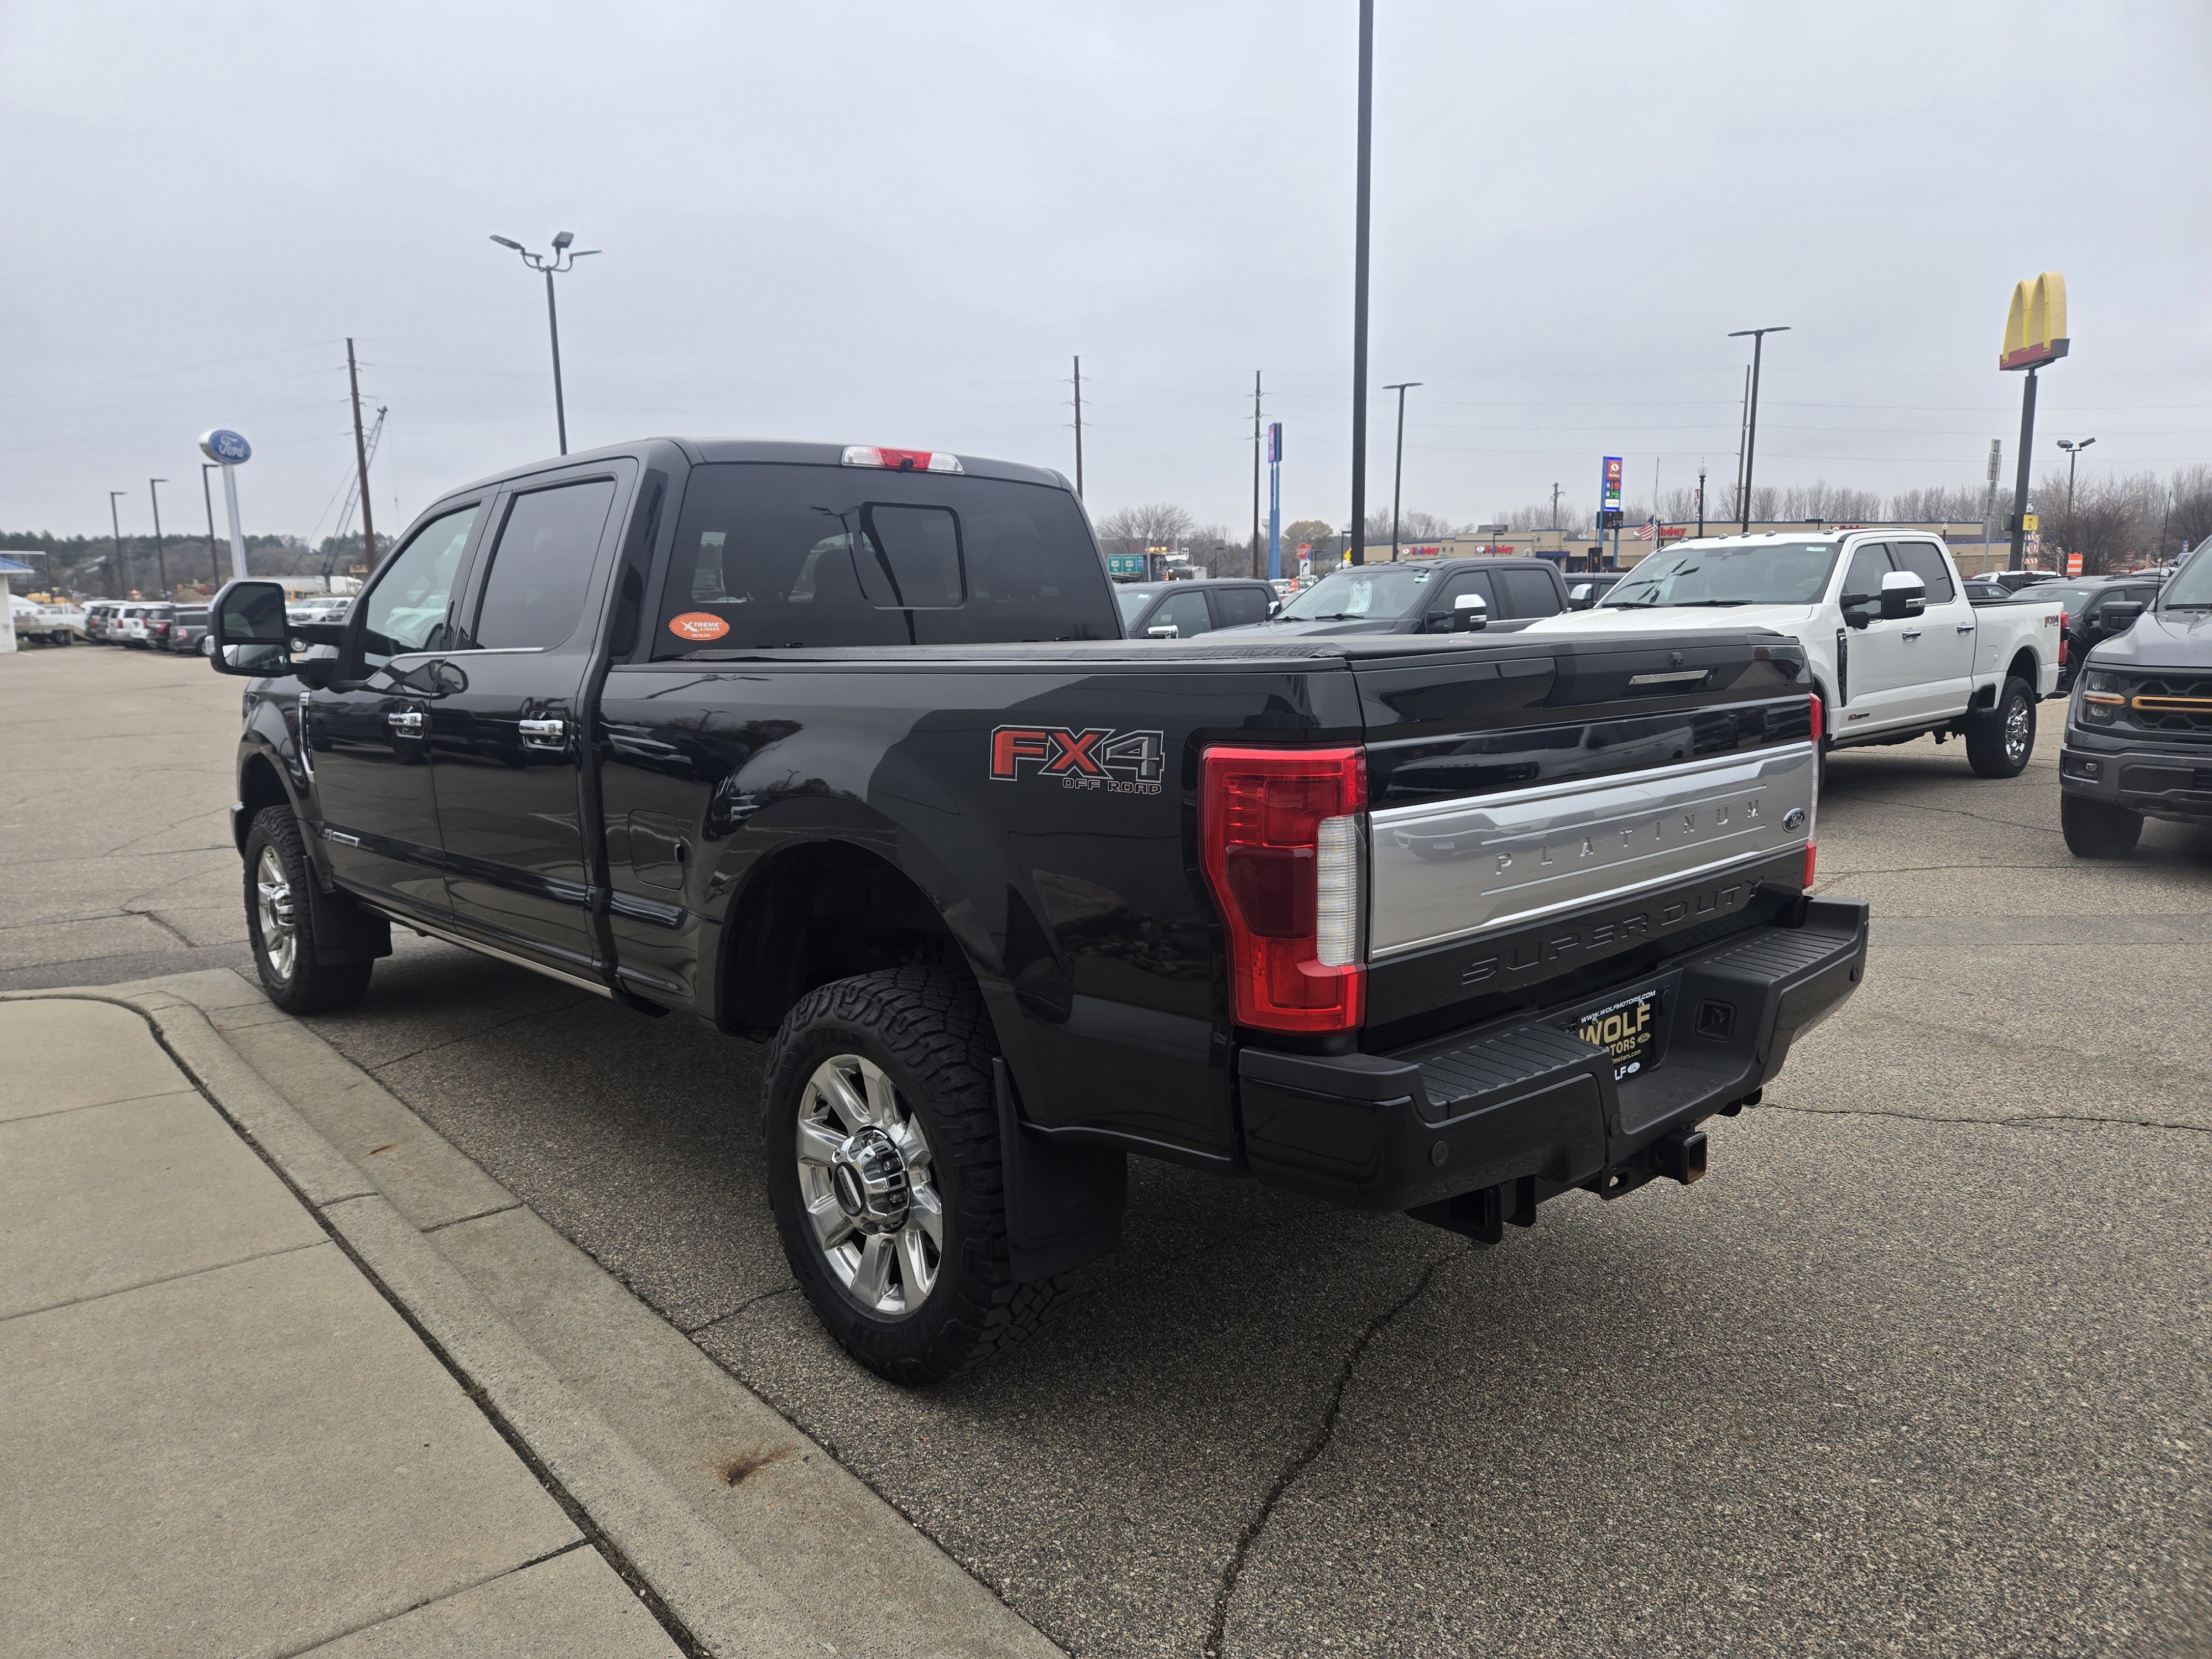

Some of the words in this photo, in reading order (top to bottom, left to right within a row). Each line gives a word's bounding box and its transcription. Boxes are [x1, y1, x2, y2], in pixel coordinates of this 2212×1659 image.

[218, 435, 244, 458] Ford
[1411, 546, 1439, 556] Holiday
[1485, 545, 1514, 554] Holiday
[680, 620, 719, 632] XTREME
[2044, 614, 2059, 627] FX4
[990, 724, 1165, 782] FX4
[1062, 777, 1100, 790] OFF
[1107, 780, 1161, 795] ROAD
[1790, 812, 1803, 828] Ford
[1495, 800, 1759, 875] PLATINUM
[1462, 912, 1648, 985] SUPER
[1661, 875, 1764, 926] DUTY
[1580, 990, 1656, 1024] WWW.WOLFMOTORS.COM
[1579, 1003, 1650, 1046] WOLF
[1605, 1036, 1636, 1056] TORS
